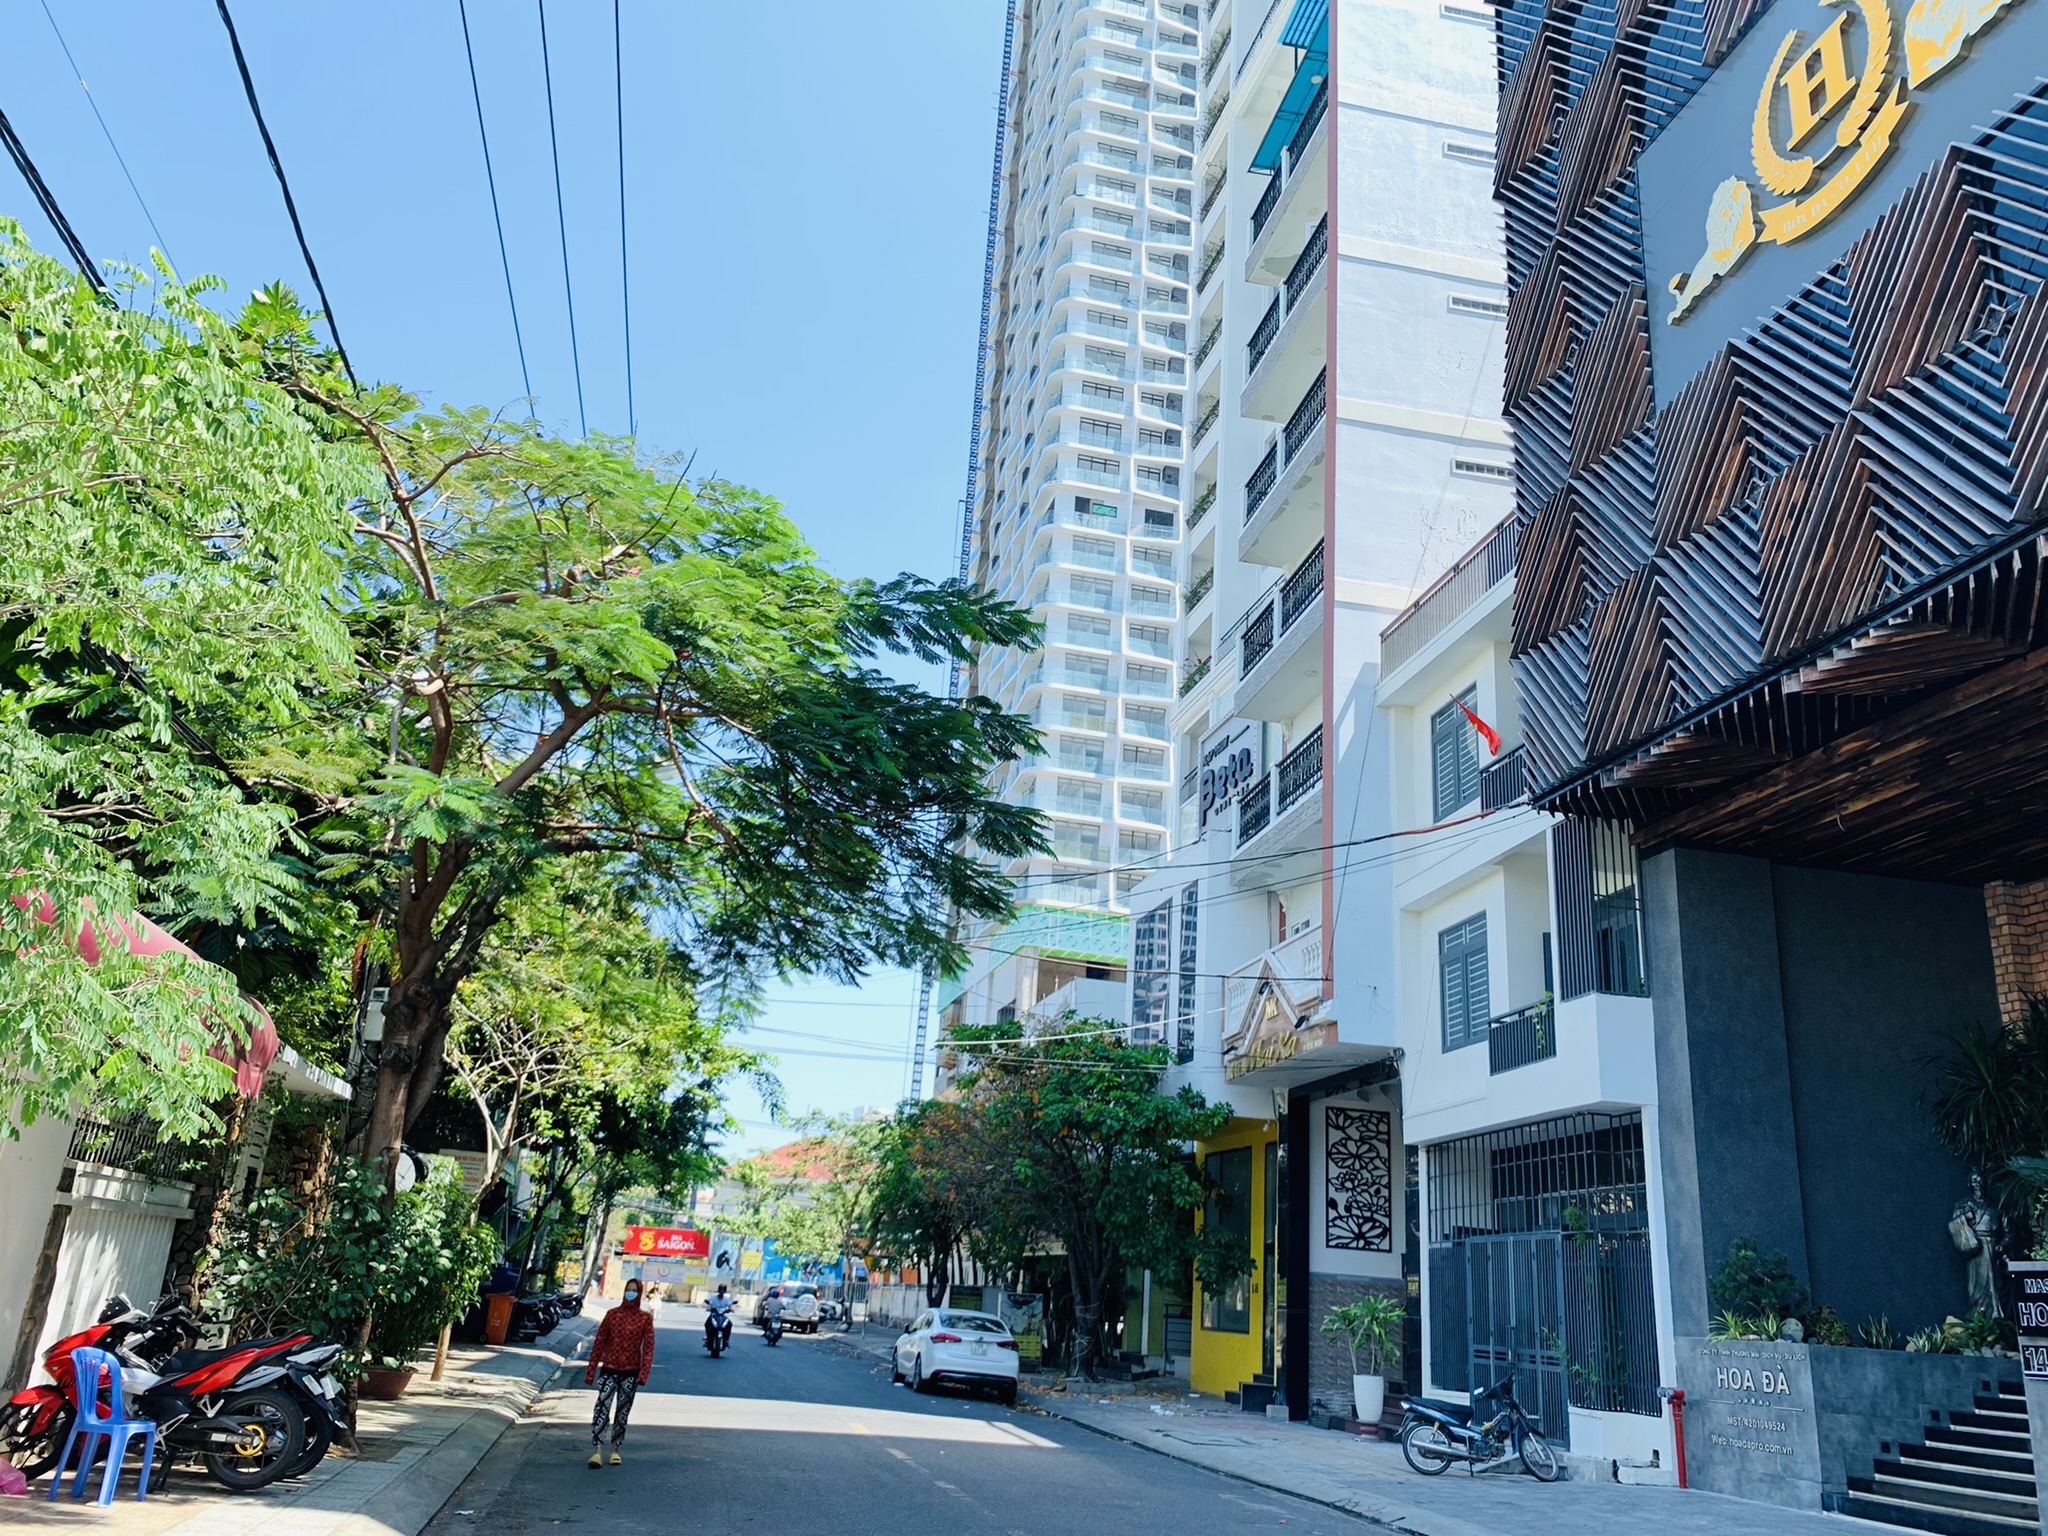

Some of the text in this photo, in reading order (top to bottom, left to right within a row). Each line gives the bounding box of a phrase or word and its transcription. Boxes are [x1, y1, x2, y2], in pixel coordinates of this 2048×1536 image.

[1780, 10, 1857, 152] H
[1200, 747, 1253, 827] Beta
[2018, 1302, 2048, 1327] HO
[1717, 1364, 1791, 1395] HOA ĐÀ
